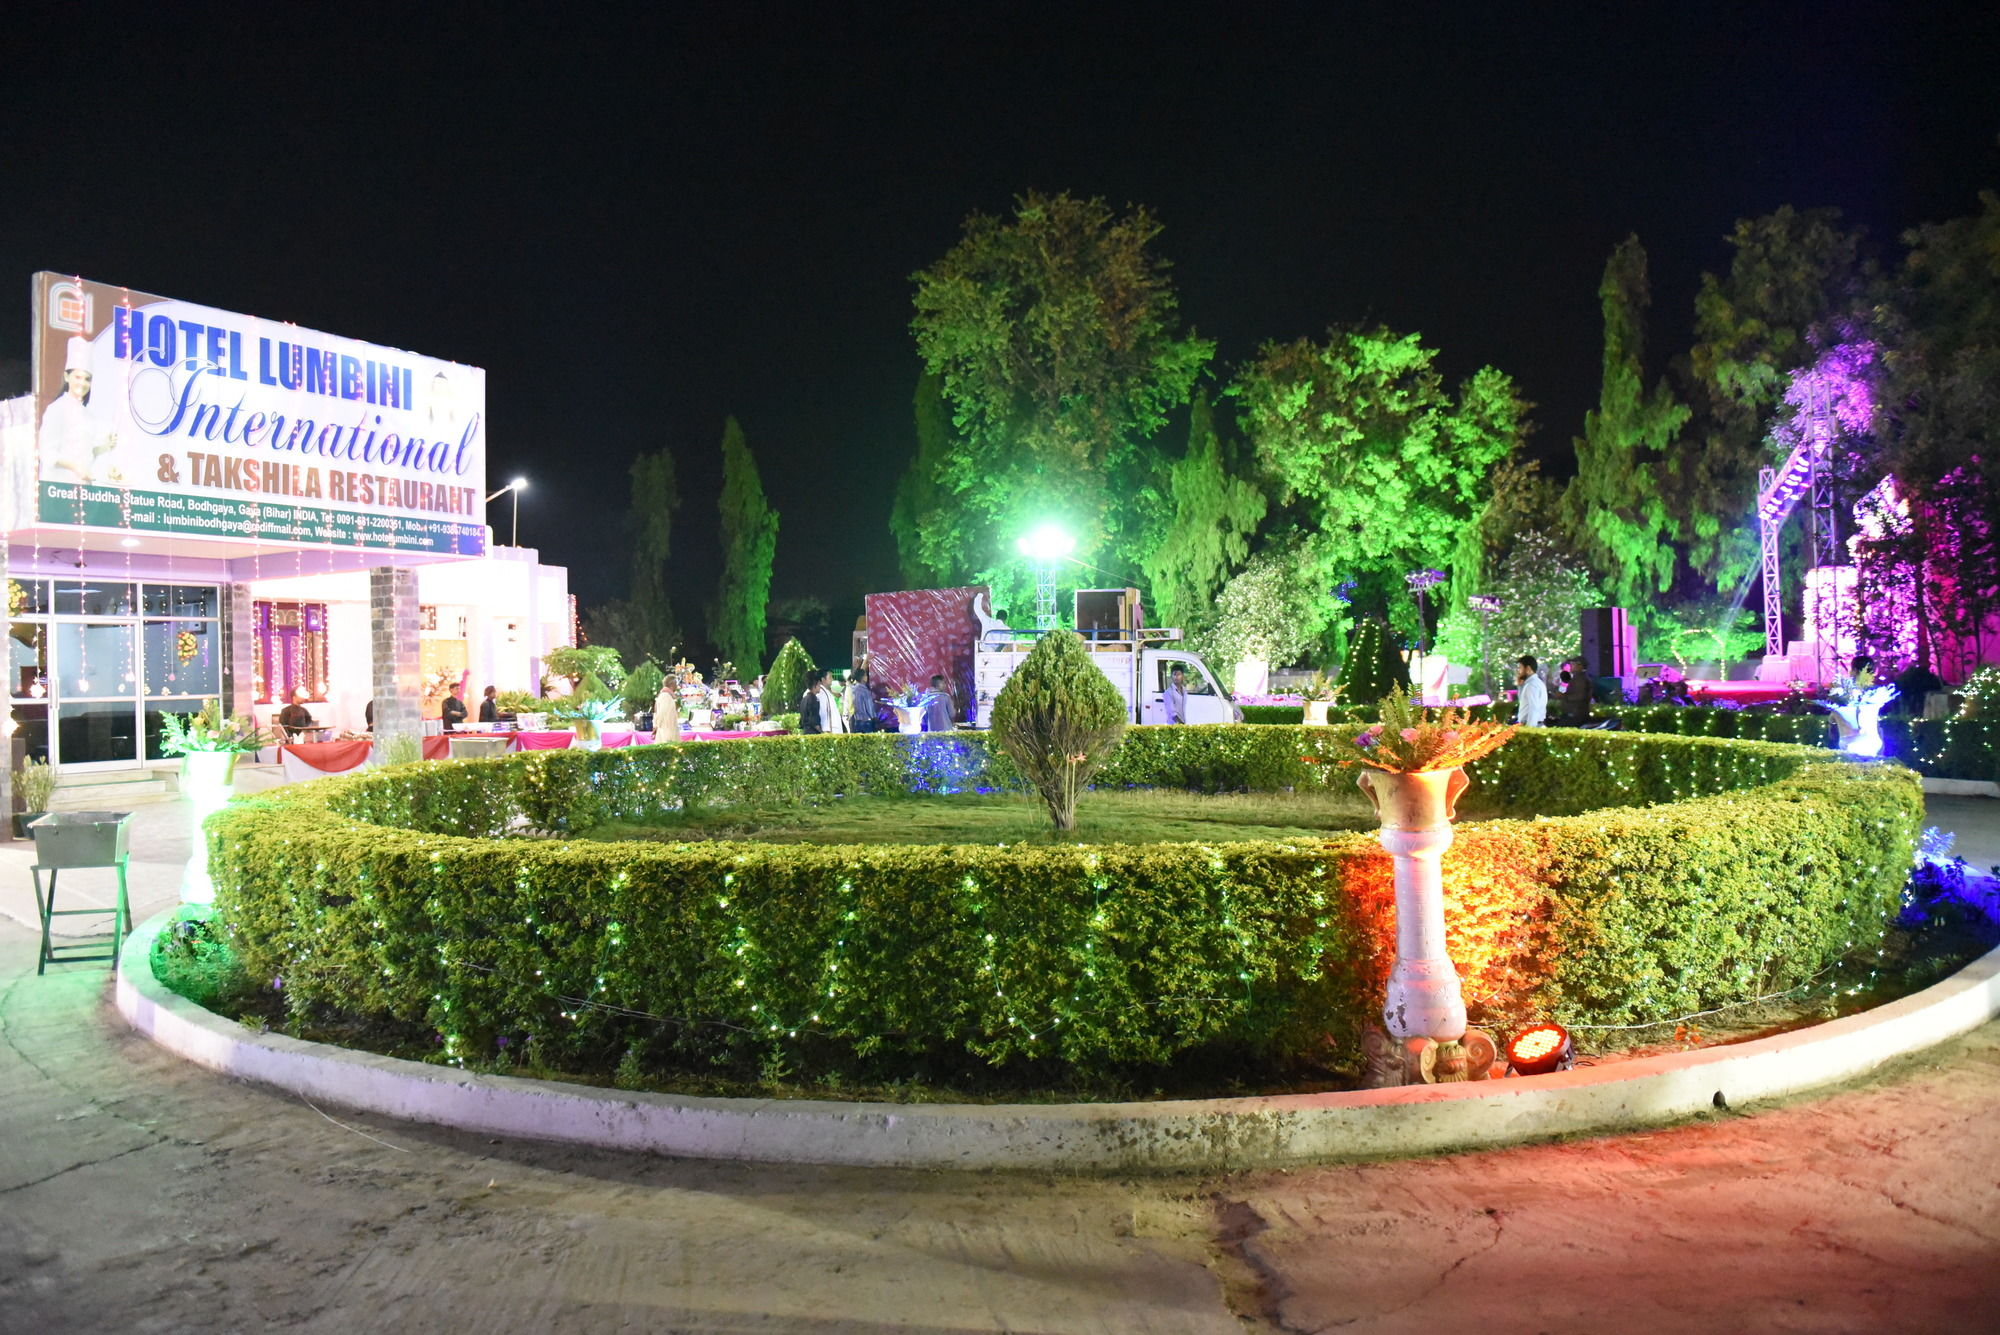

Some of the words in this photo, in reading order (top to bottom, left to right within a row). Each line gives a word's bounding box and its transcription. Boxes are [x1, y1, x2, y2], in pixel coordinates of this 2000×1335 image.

[113, 306, 247, 381] HOTEL
[259, 337, 413, 411] LUMBINI
[128, 347, 480, 476] International
[47, 485, 78, 500] Great
[80, 489, 120, 504] Buddha
[123, 492, 155, 507] Statue
[157, 496, 186, 511] Road,
[188, 499, 236, 516] Bodhgaya,
[238, 503, 261, 519] Gaya
[263, 506, 292, 522] (Bihar)
[293, 508, 319, 524] INDIA,
[157, 452, 180, 484] &
[187, 451, 322, 499] TAKSHILA
[328, 470, 476, 515] RESTAURANT
[123, 510, 155, 524] E-mail
[163, 515, 313, 537] lumbinibodhgaya@rediffmail.com,
[315, 523, 347, 540] Website
